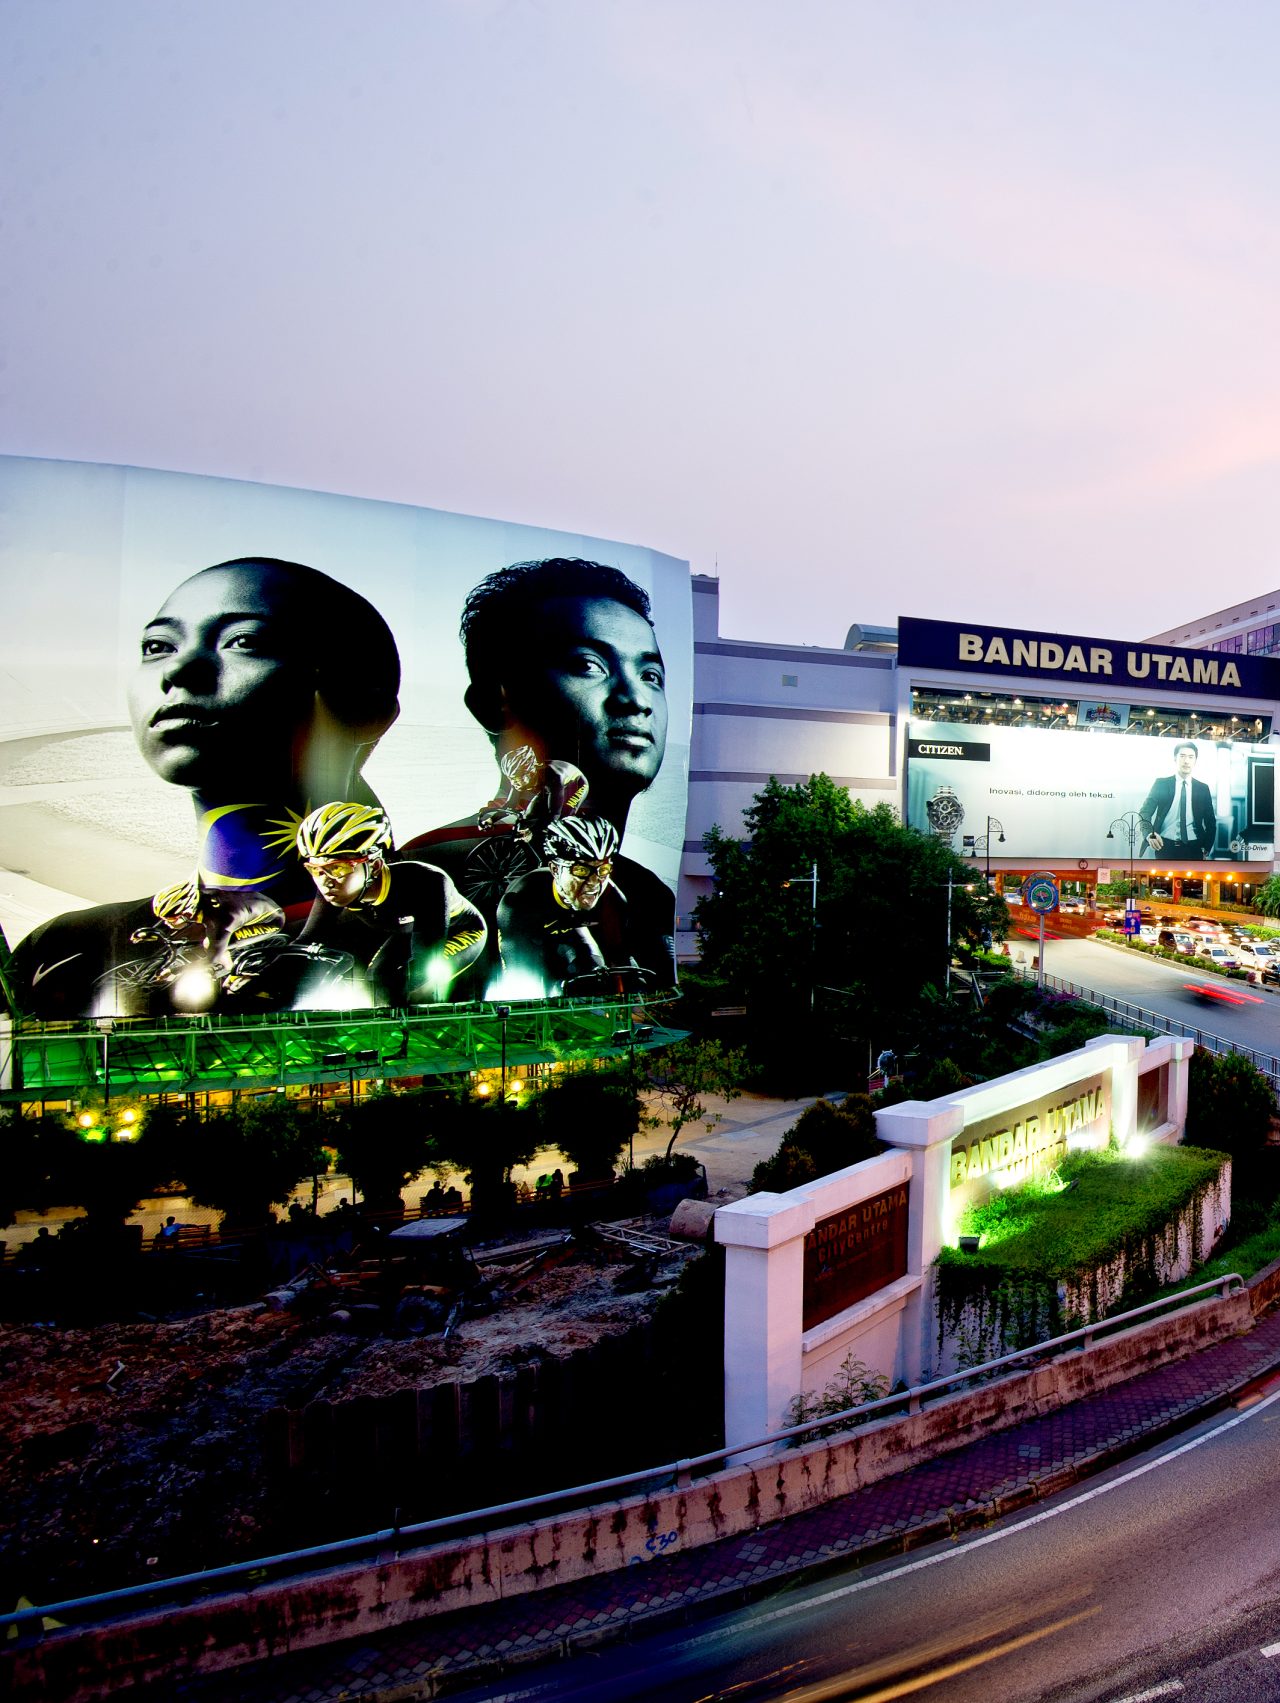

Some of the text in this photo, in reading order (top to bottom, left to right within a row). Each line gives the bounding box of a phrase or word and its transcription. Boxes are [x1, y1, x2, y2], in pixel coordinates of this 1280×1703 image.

[959, 633, 1242, 688] BANDAR UTAMA
[918, 744, 963, 756] CITIZEN
[989, 787, 1024, 796] Inovasi,
[1026, 789, 1066, 798] didorong
[951, 1114, 1041, 1190] BANDAR
[1047, 1085, 1105, 1141] UTAMA
[804, 1190, 907, 1251] ANDAR UTAMA
